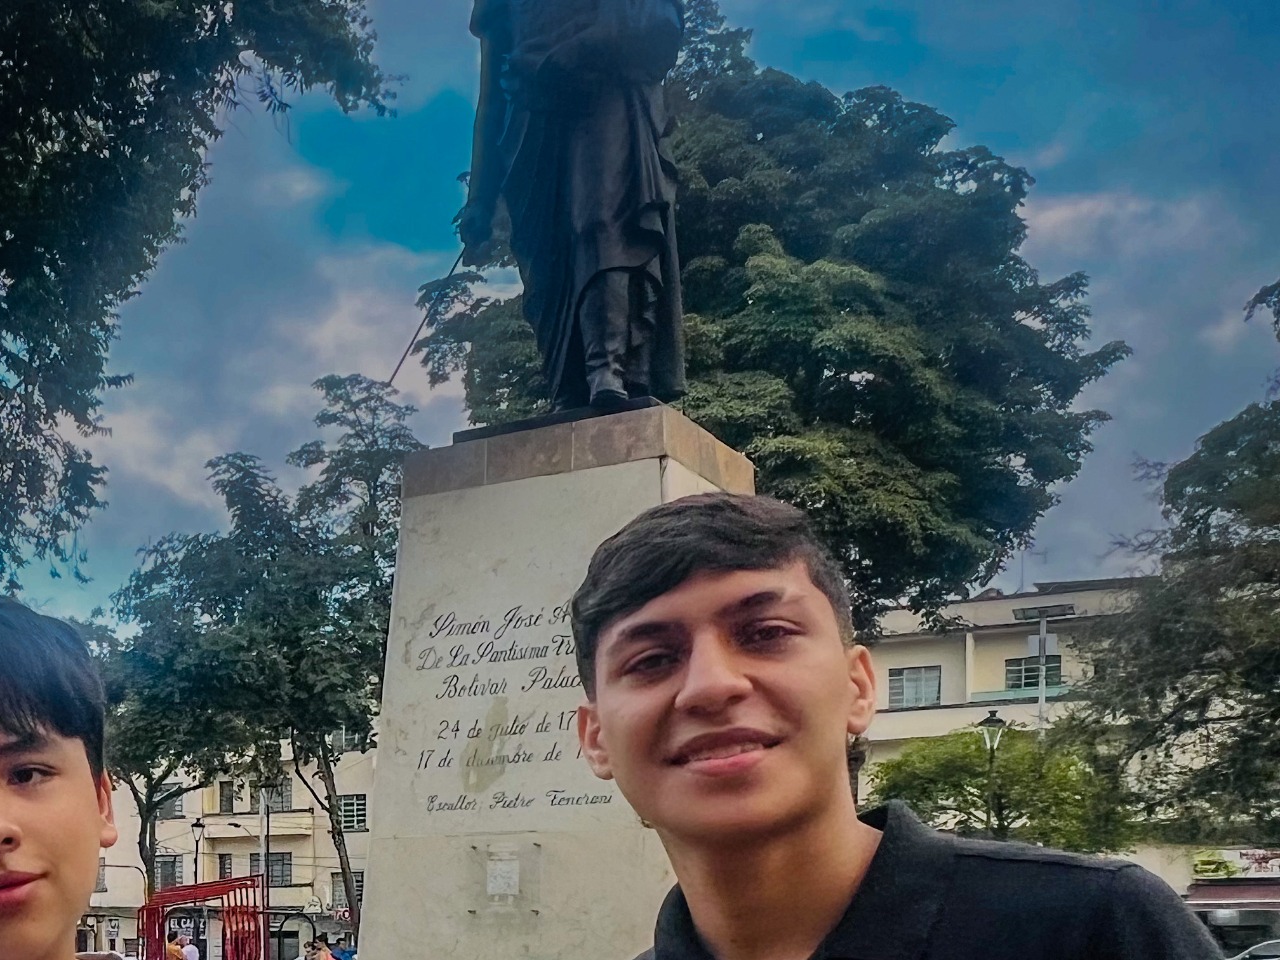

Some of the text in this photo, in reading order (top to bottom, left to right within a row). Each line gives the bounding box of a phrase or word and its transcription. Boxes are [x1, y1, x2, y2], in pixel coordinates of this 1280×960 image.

[429, 611, 490, 638] Simón
[494, 604, 544, 640] José
[416, 646, 444, 671] De
[447, 644, 470, 668] La
[437, 719, 460, 739] 24
[467, 718, 482, 739] de
[488, 714, 529, 741] julio
[535, 712, 552, 733] de
[417, 749, 435, 770] 17
[438, 749, 454, 768] de
[542, 741, 562, 762] de
